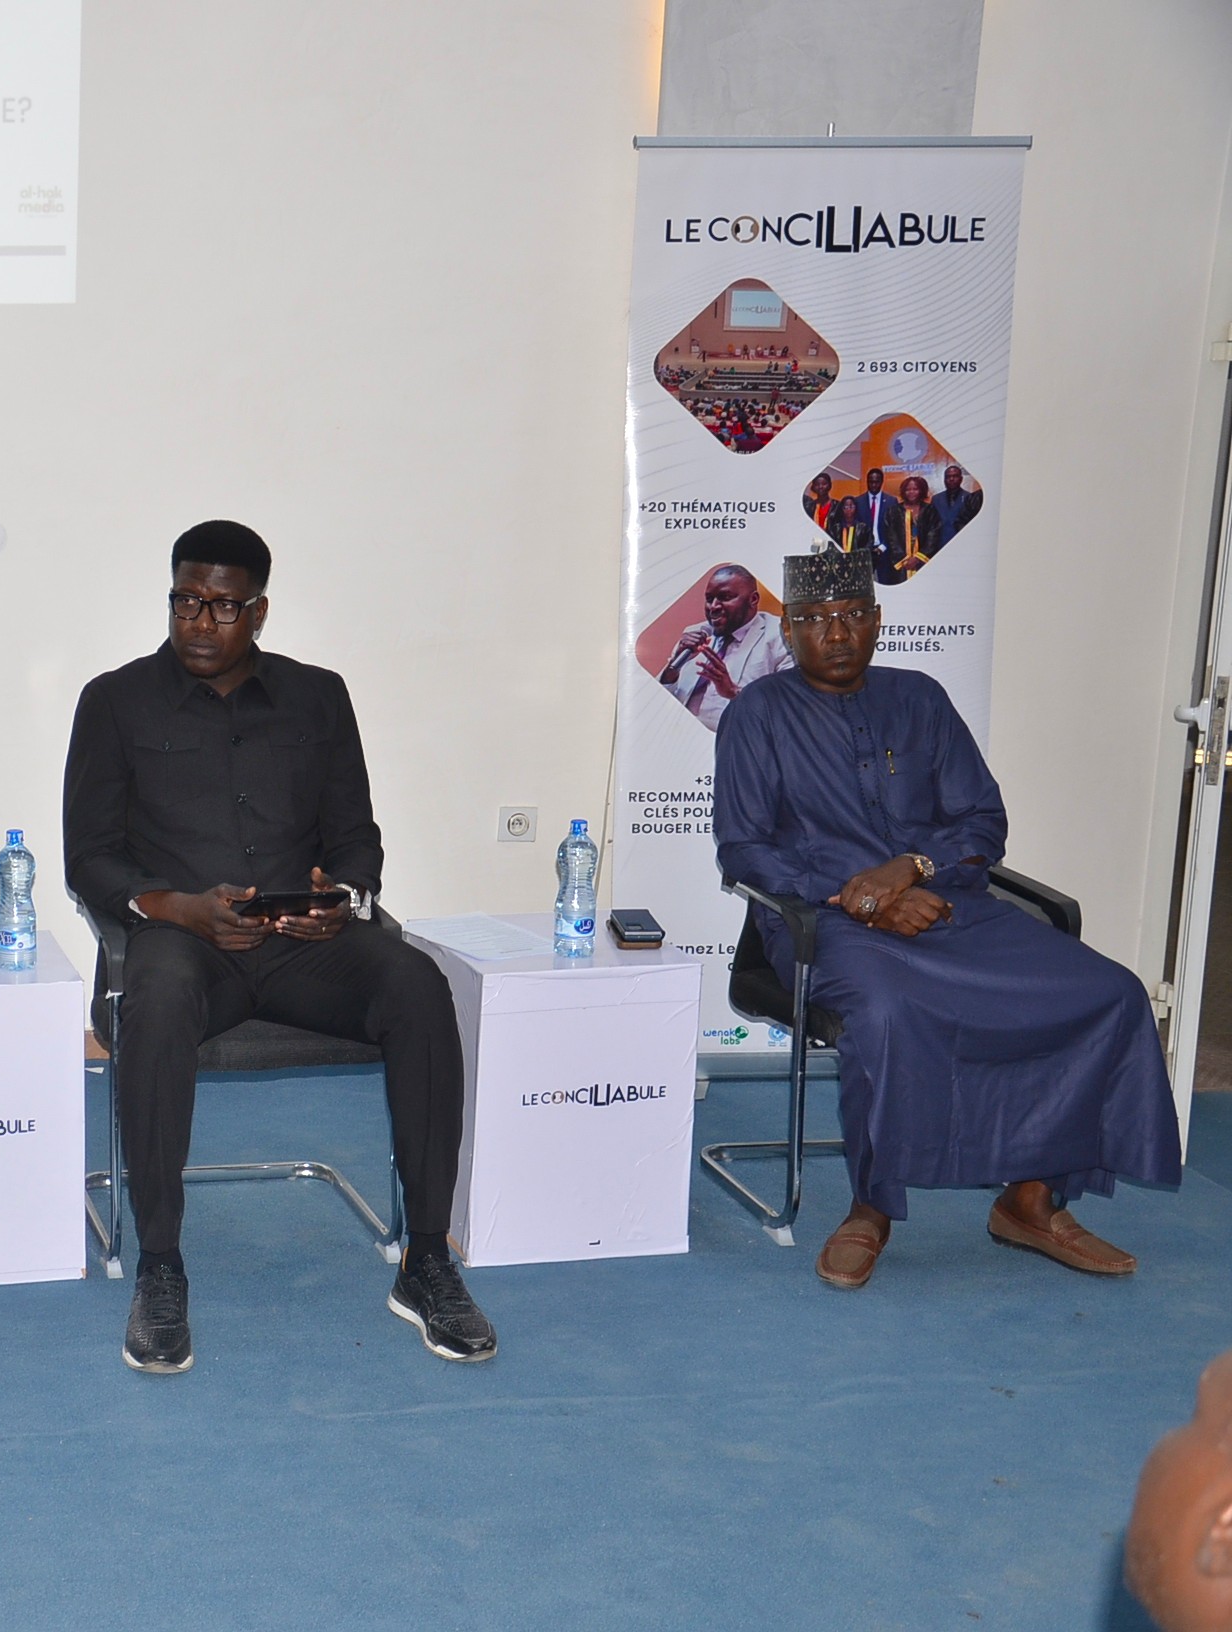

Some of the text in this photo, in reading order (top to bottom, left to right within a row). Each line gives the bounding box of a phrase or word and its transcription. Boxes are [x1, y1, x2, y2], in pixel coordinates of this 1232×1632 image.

[902, 361, 978, 373] CITOYENS
[639, 498, 776, 514] +20 THÉMATIQUES
[664, 515, 747, 529] EXPLORÉES
[880, 625, 975, 636] TERVENANTS
[875, 638, 945, 652] OBILISÉS.
[694, 775, 712, 786] +3
[628, 791, 715, 802] RECOMMAN
[643, 804, 714, 818] CLÉS POU
[631, 823, 714, 834] BOUGER LE
[720, 1036, 741, 1045] labs
